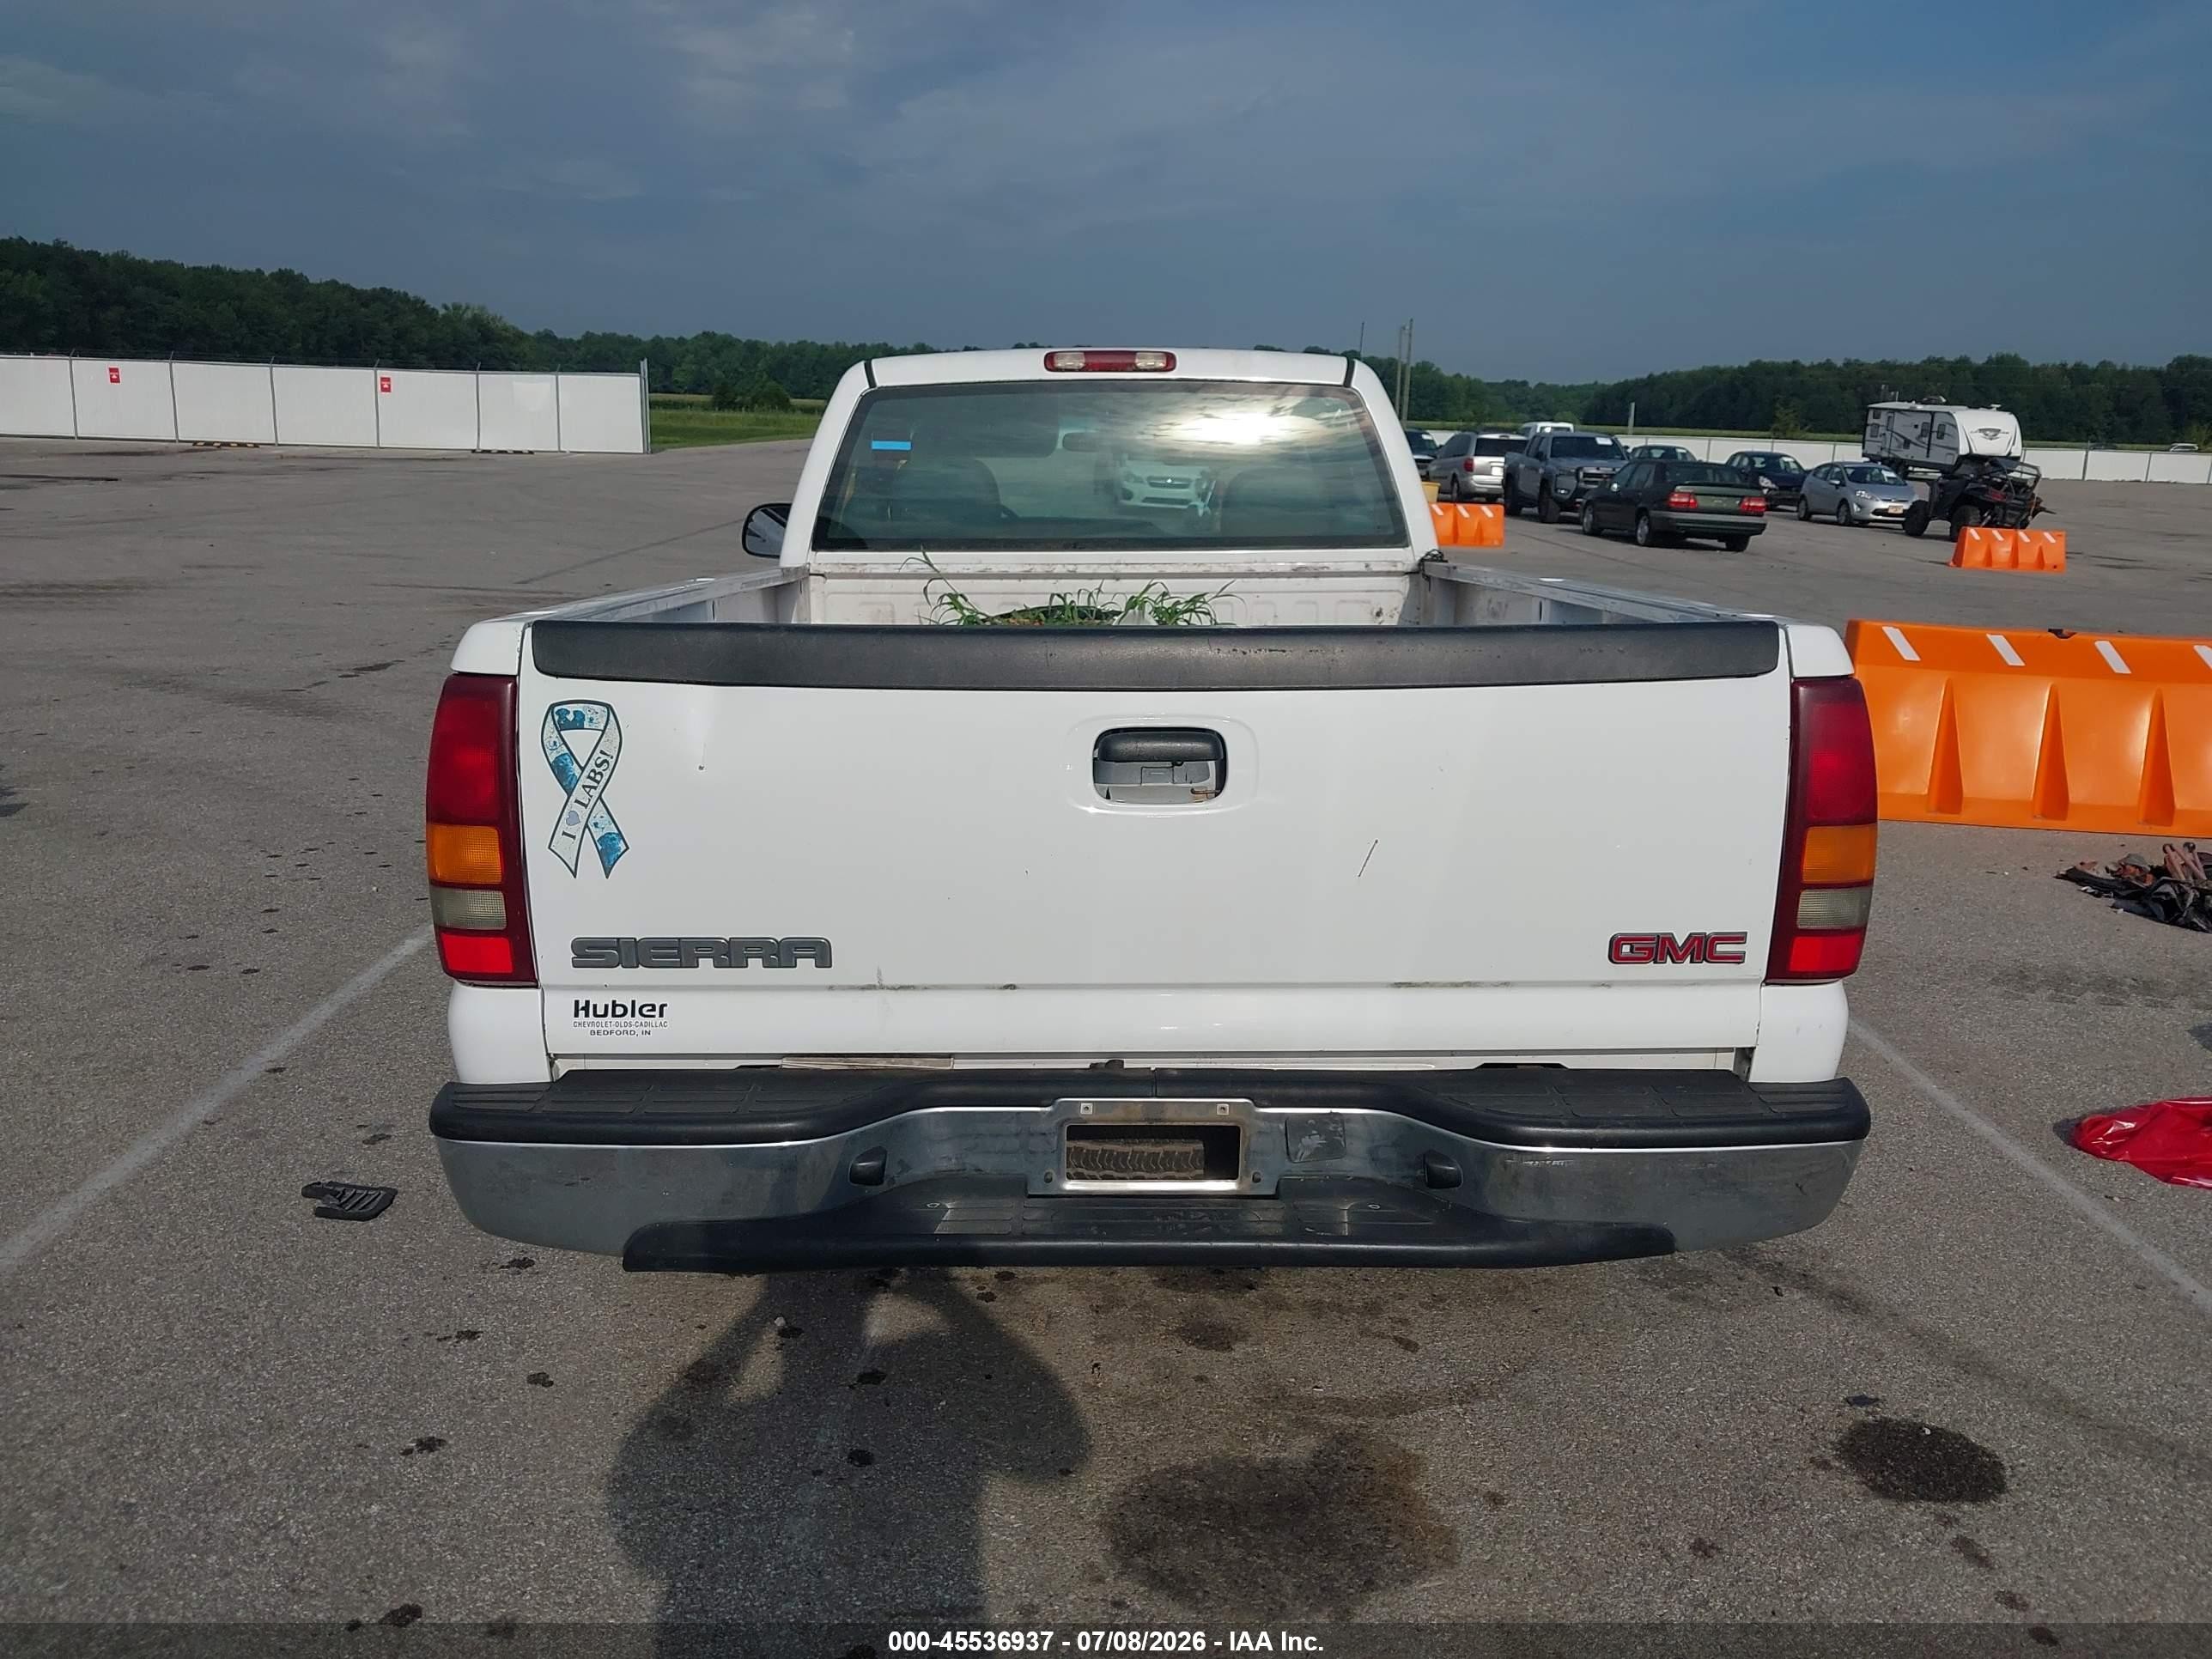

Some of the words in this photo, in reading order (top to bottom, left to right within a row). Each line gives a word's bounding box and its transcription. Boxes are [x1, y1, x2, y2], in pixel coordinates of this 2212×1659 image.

[562, 830, 576, 841] I
[574, 749, 614, 809] LABS!
[571, 937, 832, 969] SIERRA
[1607, 932, 1747, 964] GMC
[574, 999, 668, 1018] Hubler
